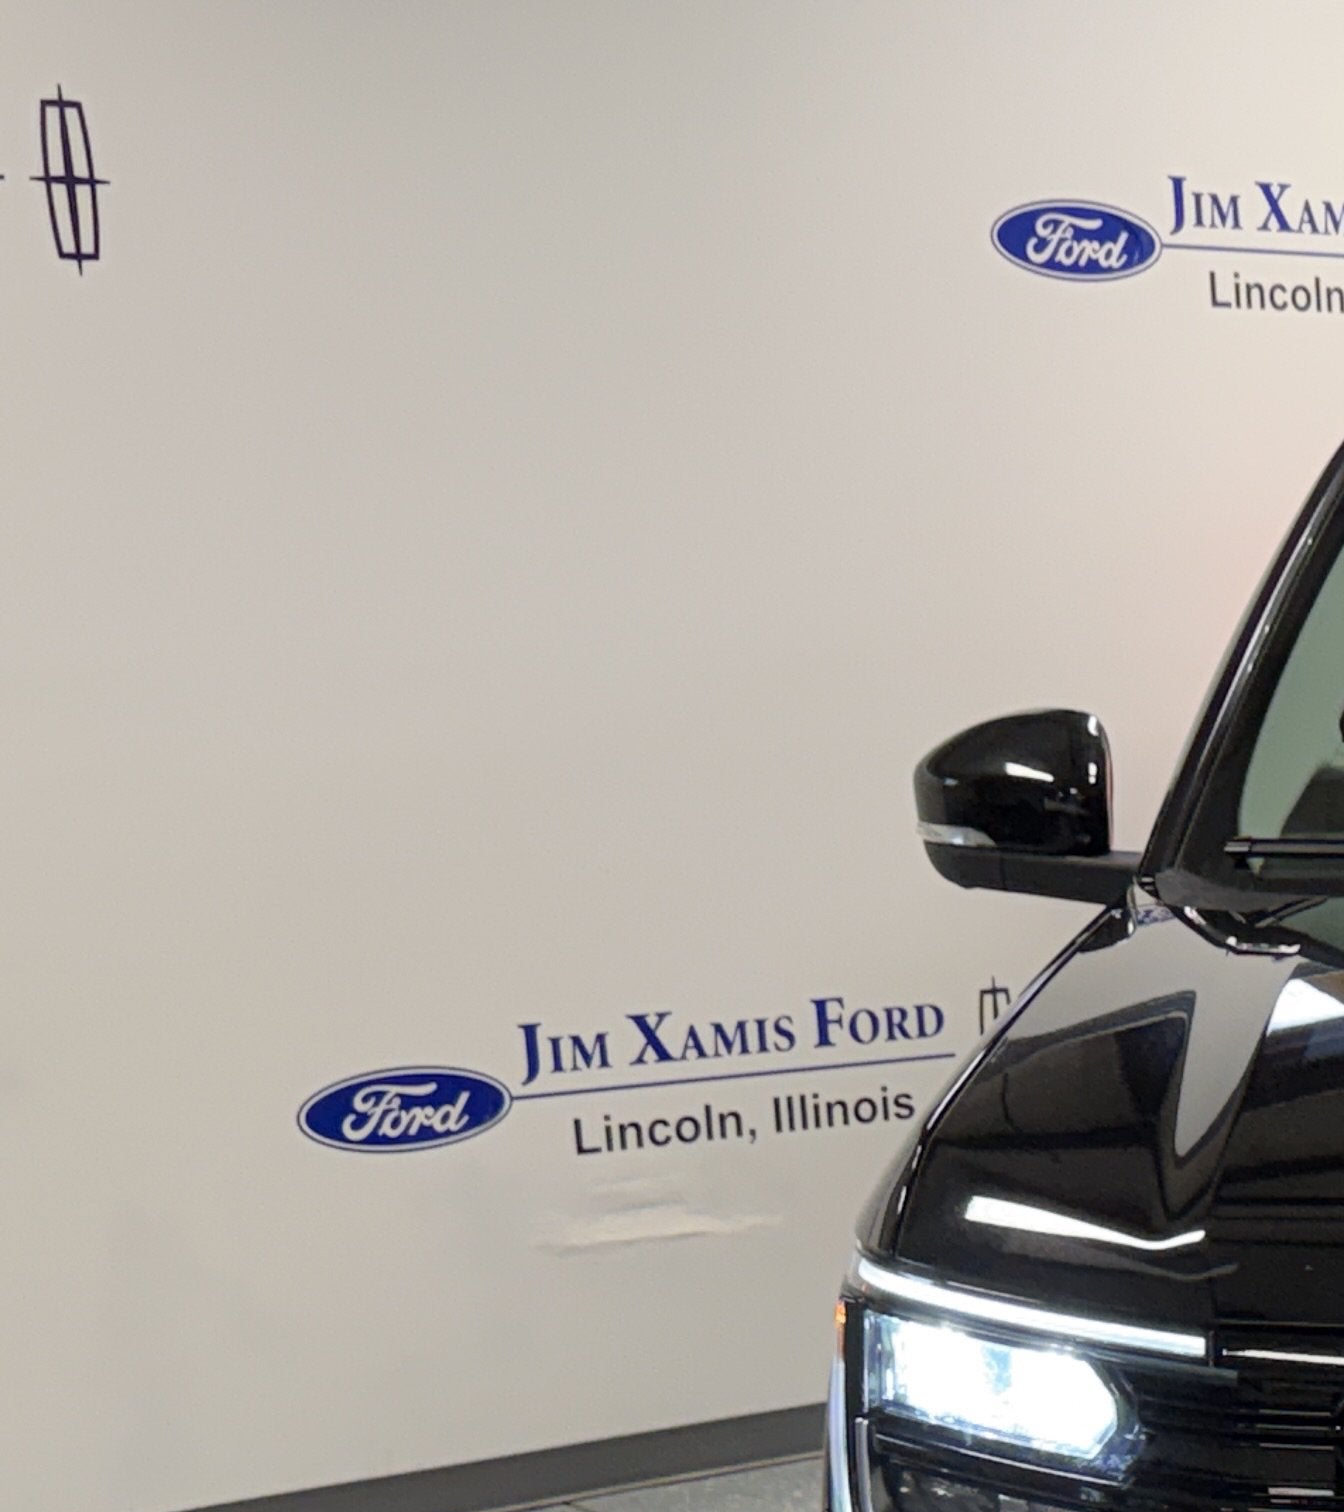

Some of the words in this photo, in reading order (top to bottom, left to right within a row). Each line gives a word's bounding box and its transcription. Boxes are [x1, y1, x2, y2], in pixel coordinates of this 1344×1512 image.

[1167, 175, 1242, 236] JIM
[1026, 213, 1128, 270] Ford
[517, 1023, 611, 1086] JIM
[624, 1010, 797, 1064] XAMIS
[809, 997, 946, 1049] FORD
[341, 1082, 470, 1142] Ford
[573, 1104, 758, 1155] Lincoln,
[773, 1086, 916, 1133] Illinois
